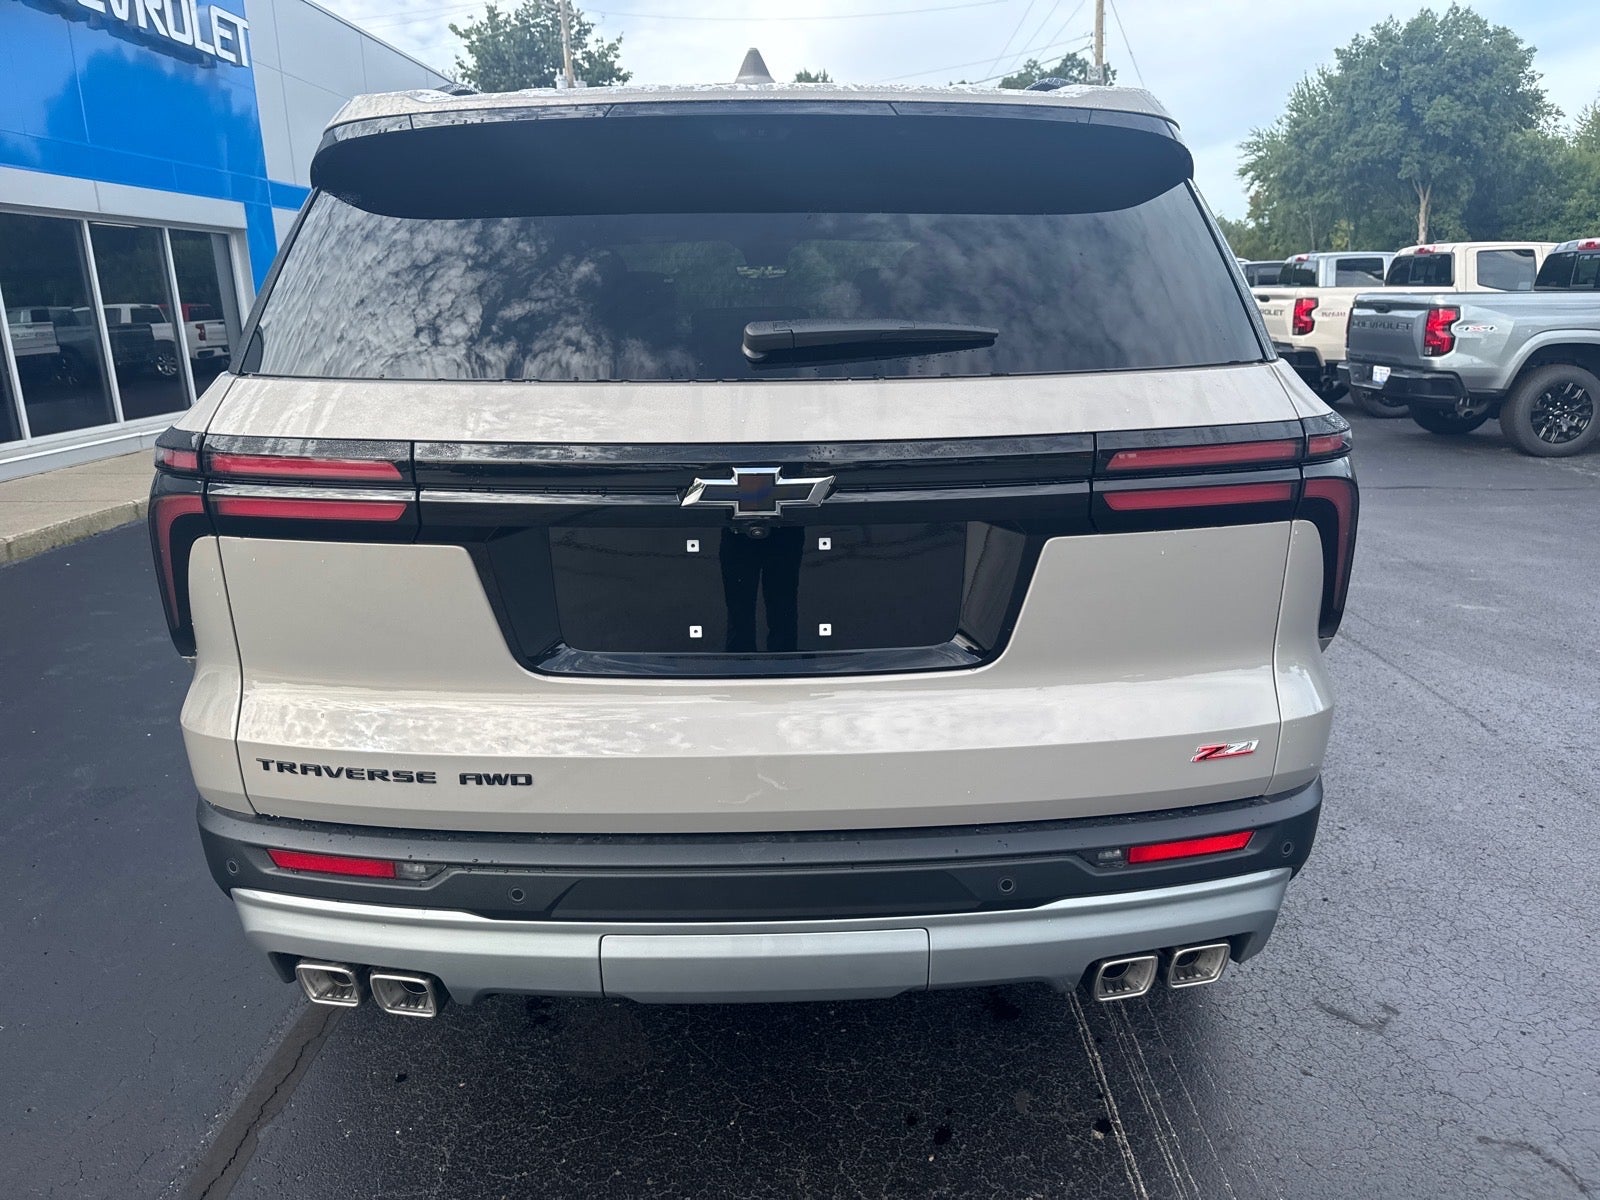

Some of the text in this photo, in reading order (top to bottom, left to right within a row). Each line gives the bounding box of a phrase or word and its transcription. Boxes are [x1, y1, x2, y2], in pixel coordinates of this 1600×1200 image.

[77, 0, 249, 68] ROLET
[1190, 739, 1260, 762] Z71
[256, 757, 533, 786] TRAVERSE AWD
